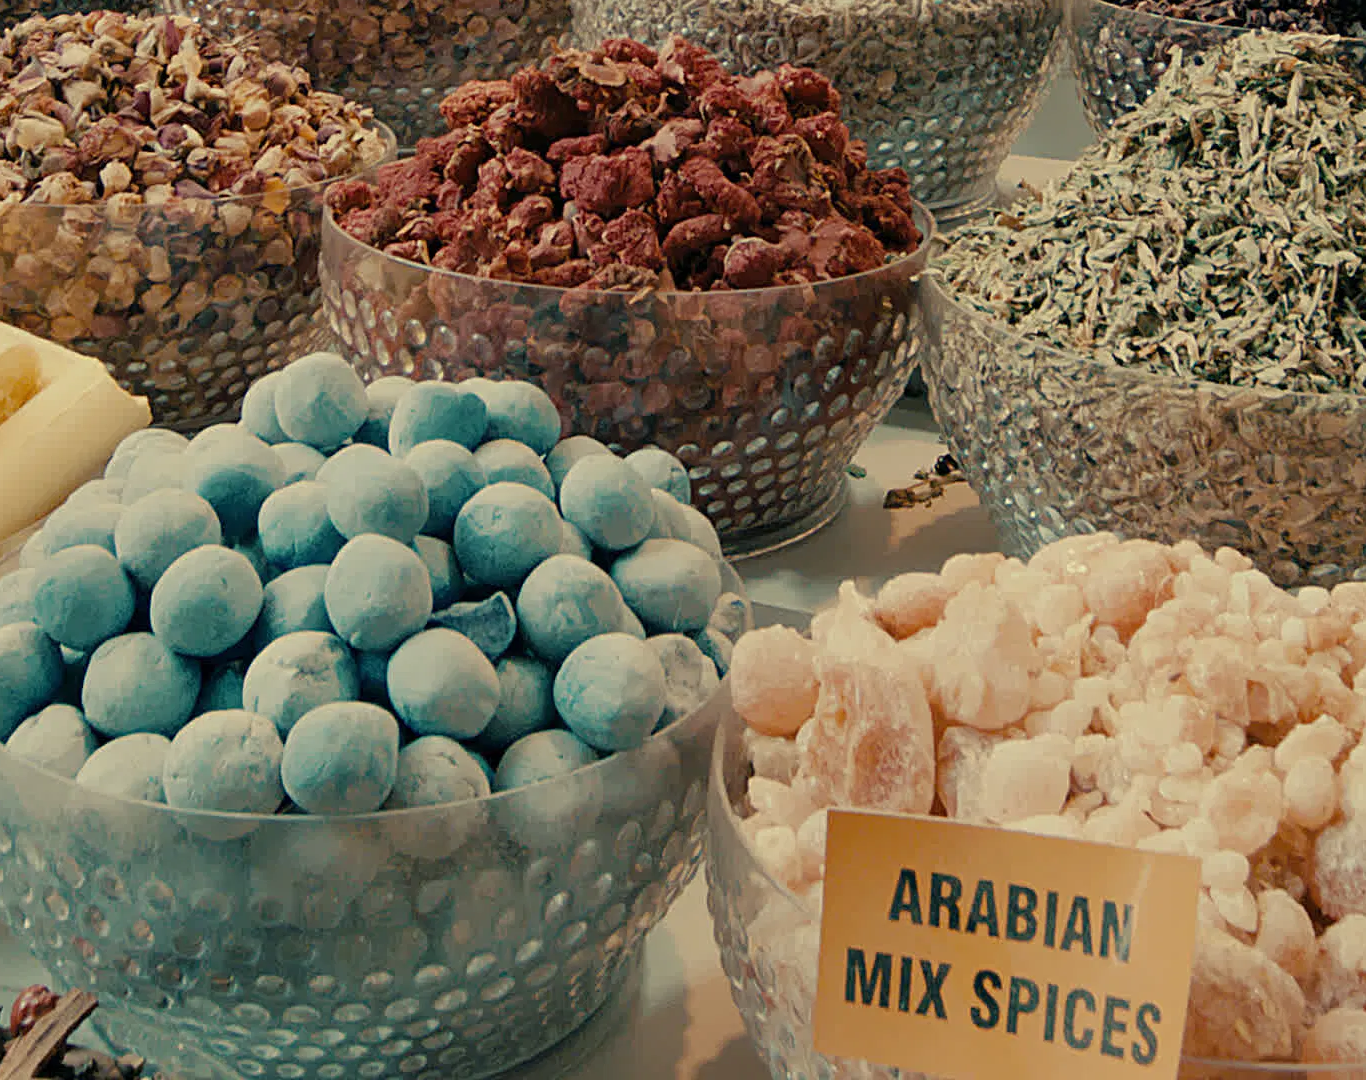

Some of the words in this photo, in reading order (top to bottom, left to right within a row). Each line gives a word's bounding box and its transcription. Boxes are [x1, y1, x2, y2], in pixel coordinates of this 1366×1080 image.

[888, 868, 1136, 963] ARABIAN
[844, 947, 952, 1020] MIX
[970, 969, 1162, 1066] SPICES
